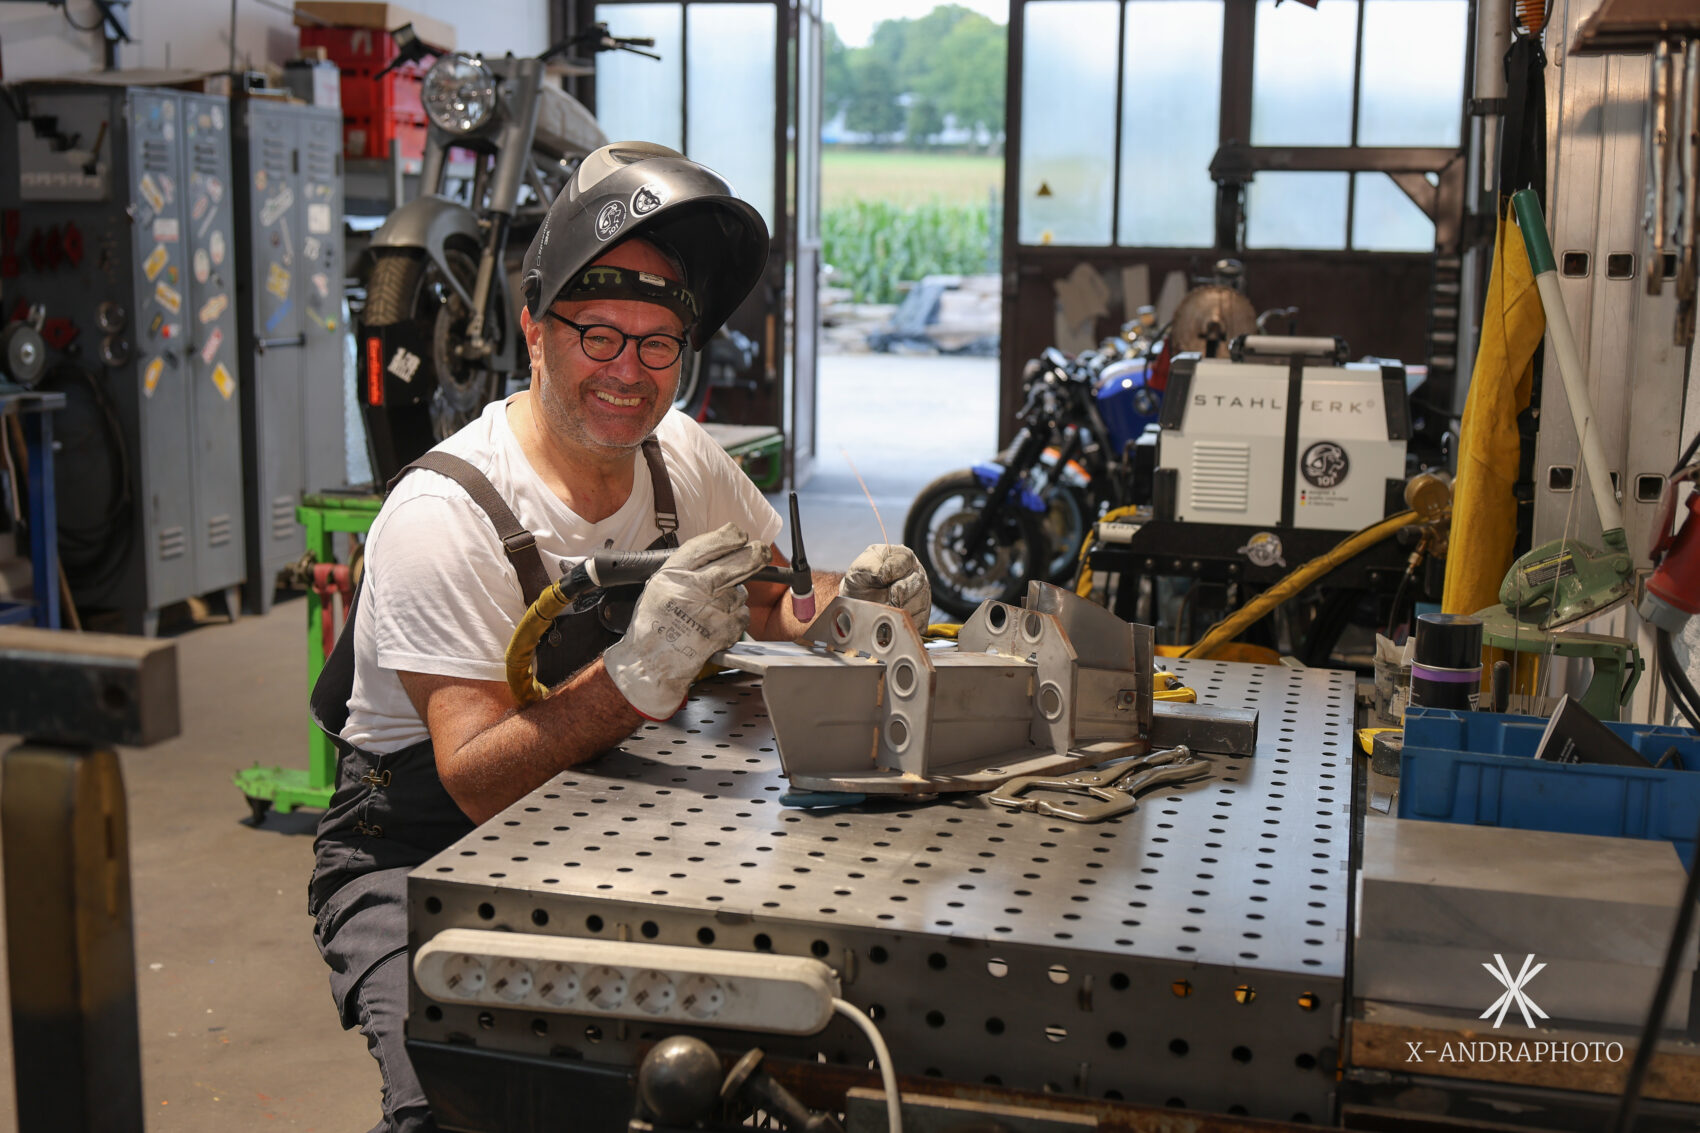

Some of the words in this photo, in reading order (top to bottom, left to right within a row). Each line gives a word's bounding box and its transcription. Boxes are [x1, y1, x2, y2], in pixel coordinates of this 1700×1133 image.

[608, 223, 619, 235] 101
[1194, 394, 1363, 414] STAHLERK
[1317, 476, 1335, 486] 101
